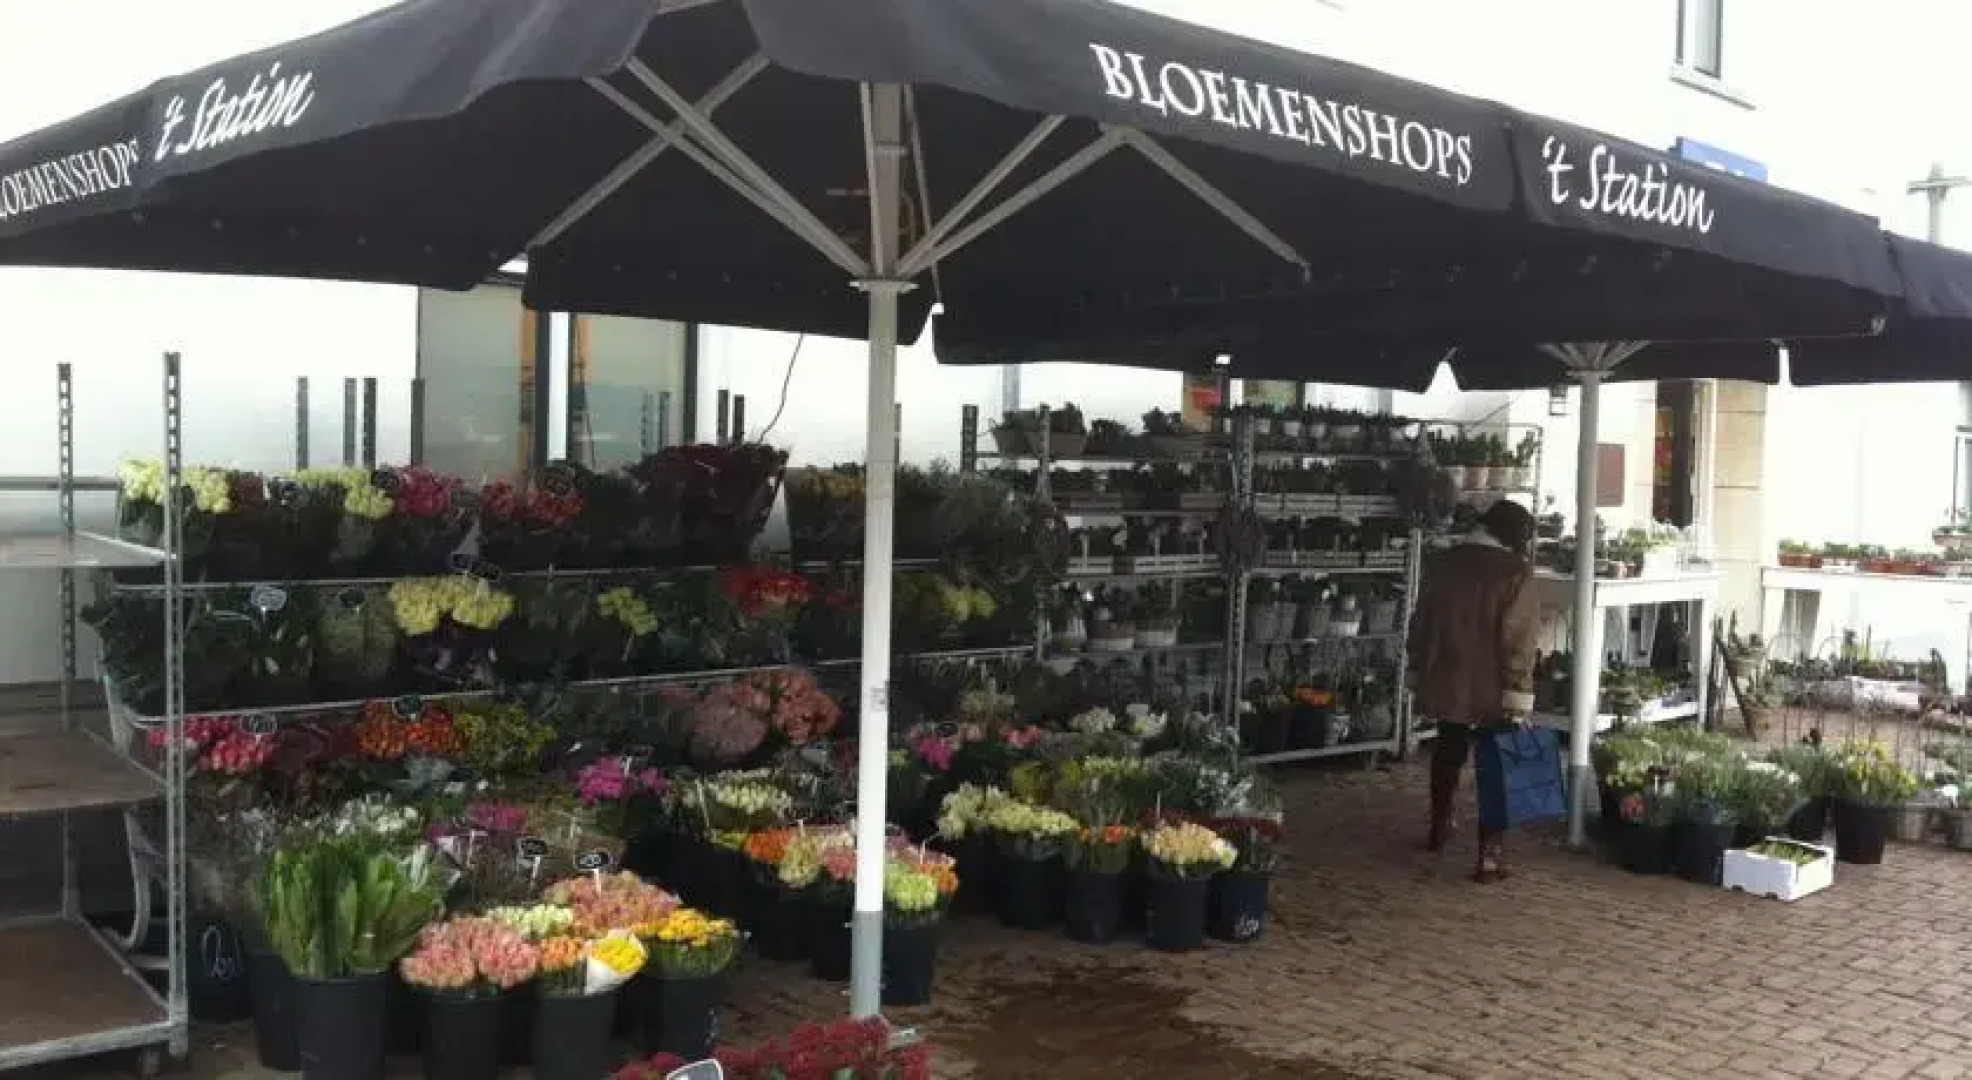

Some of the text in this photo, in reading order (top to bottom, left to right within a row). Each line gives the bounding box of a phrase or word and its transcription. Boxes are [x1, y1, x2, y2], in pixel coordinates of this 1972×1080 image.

[174, 61, 315, 155] Station
[1088, 41, 1472, 186] BLOEMENSHOPS
[1541, 134, 1715, 233] 't Station
